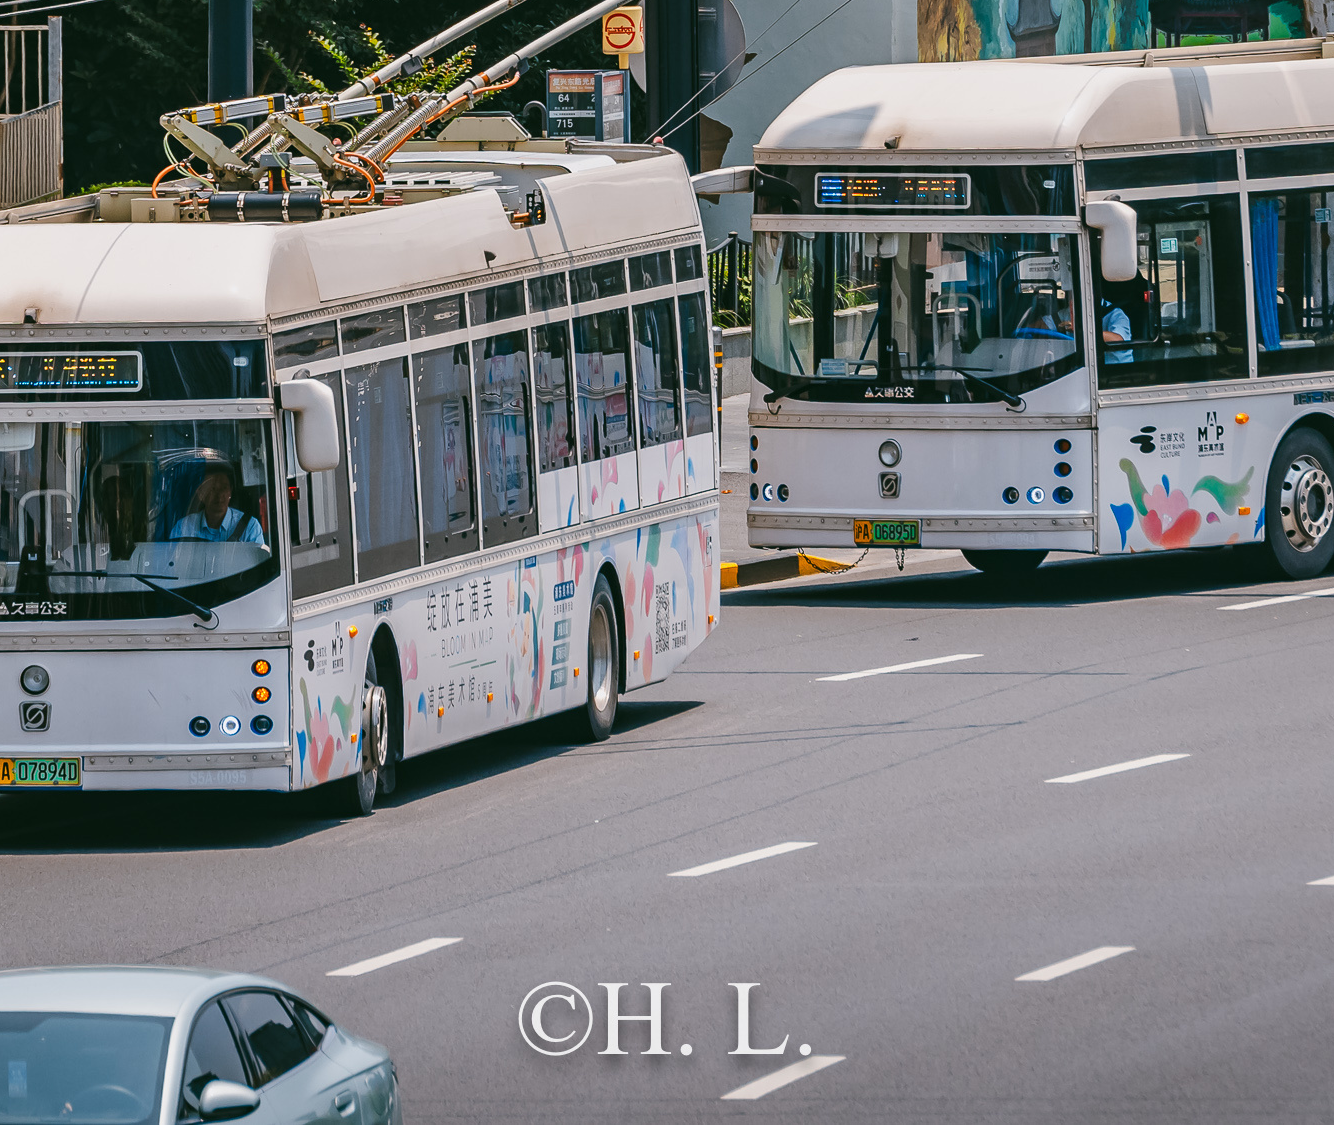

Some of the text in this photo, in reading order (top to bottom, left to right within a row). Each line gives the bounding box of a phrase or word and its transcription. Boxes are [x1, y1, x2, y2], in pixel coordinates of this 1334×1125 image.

[558, 94, 570, 103] 64
[556, 119, 574, 128] 715
[874, 523, 917, 540] 06895D
[17, 761, 78, 781] 07894D
